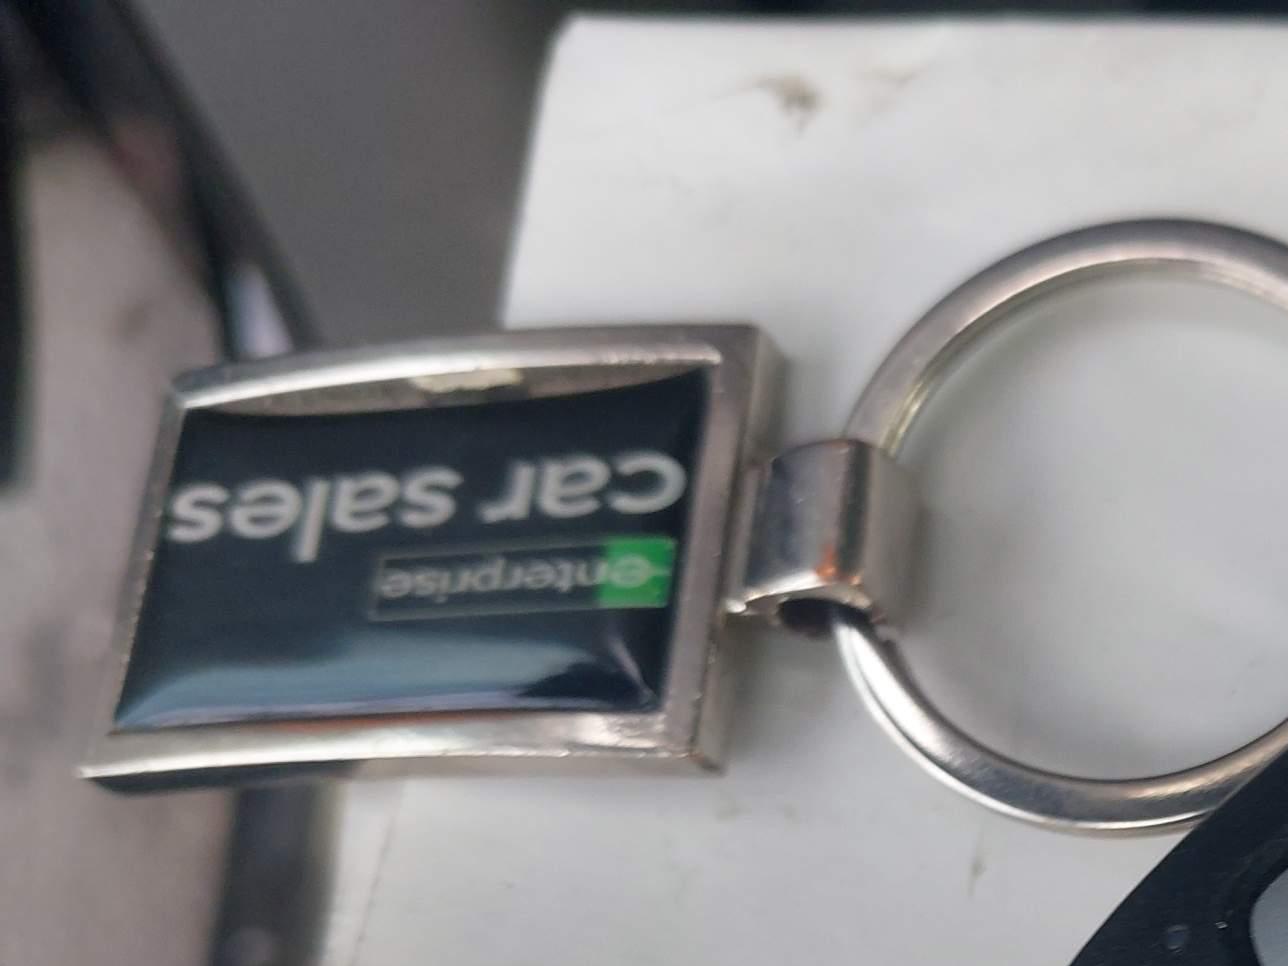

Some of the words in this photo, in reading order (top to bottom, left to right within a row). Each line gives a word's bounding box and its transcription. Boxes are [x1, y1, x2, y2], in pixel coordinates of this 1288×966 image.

[165, 464, 462, 564] sales
[483, 450, 688, 524] car
[380, 556, 656, 604] enterprise
